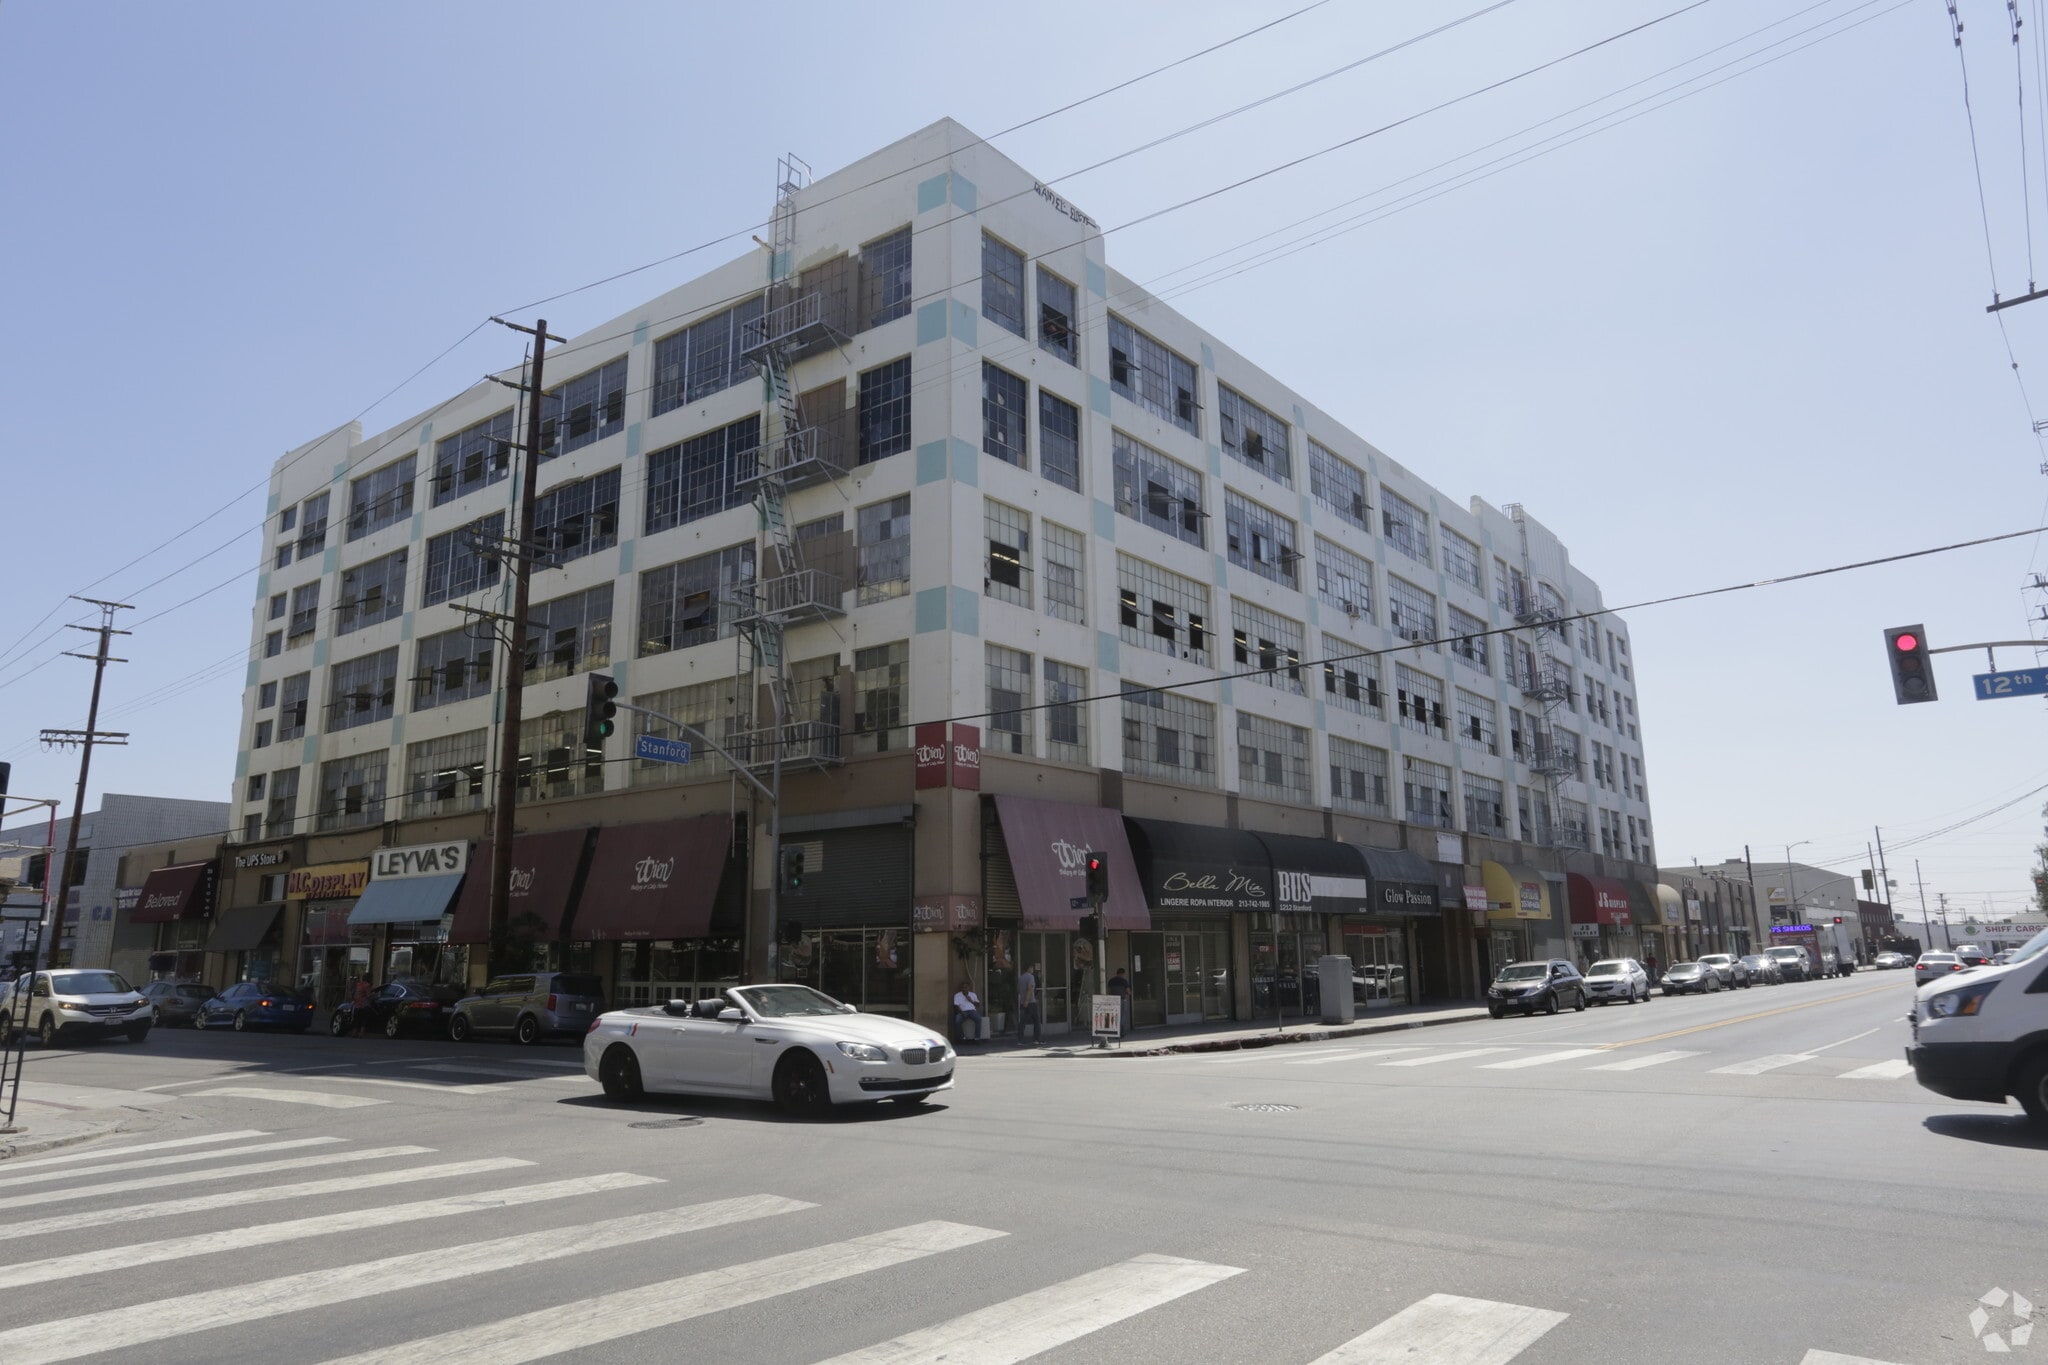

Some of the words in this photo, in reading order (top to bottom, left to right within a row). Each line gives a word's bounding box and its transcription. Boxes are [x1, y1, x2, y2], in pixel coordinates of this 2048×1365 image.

[1982, 674, 2033, 695] 12th
[641, 741, 687, 758] Stanford
[235, 856, 247, 868] The
[247, 854, 259, 866] UPS
[260, 853, 276, 865] Store
[377, 845, 460, 877] LEYVA'S
[1163, 872, 1219, 891] Bella
[1225, 868, 1266, 897] Mia
[1278, 871, 1312, 903] BUS
[144, 890, 183, 909] Beloved
[1160, 898, 1189, 906] LINGERIE
[1190, 899, 1207, 907] ROPA
[1208, 899, 1234, 907] INTERIOR
[1385, 888, 1404, 904] Glow
[1405, 890, 1432, 905] Passion
[1293, 904, 1312, 912] Stanford
[1985, 925, 2012, 933] SHIFF
